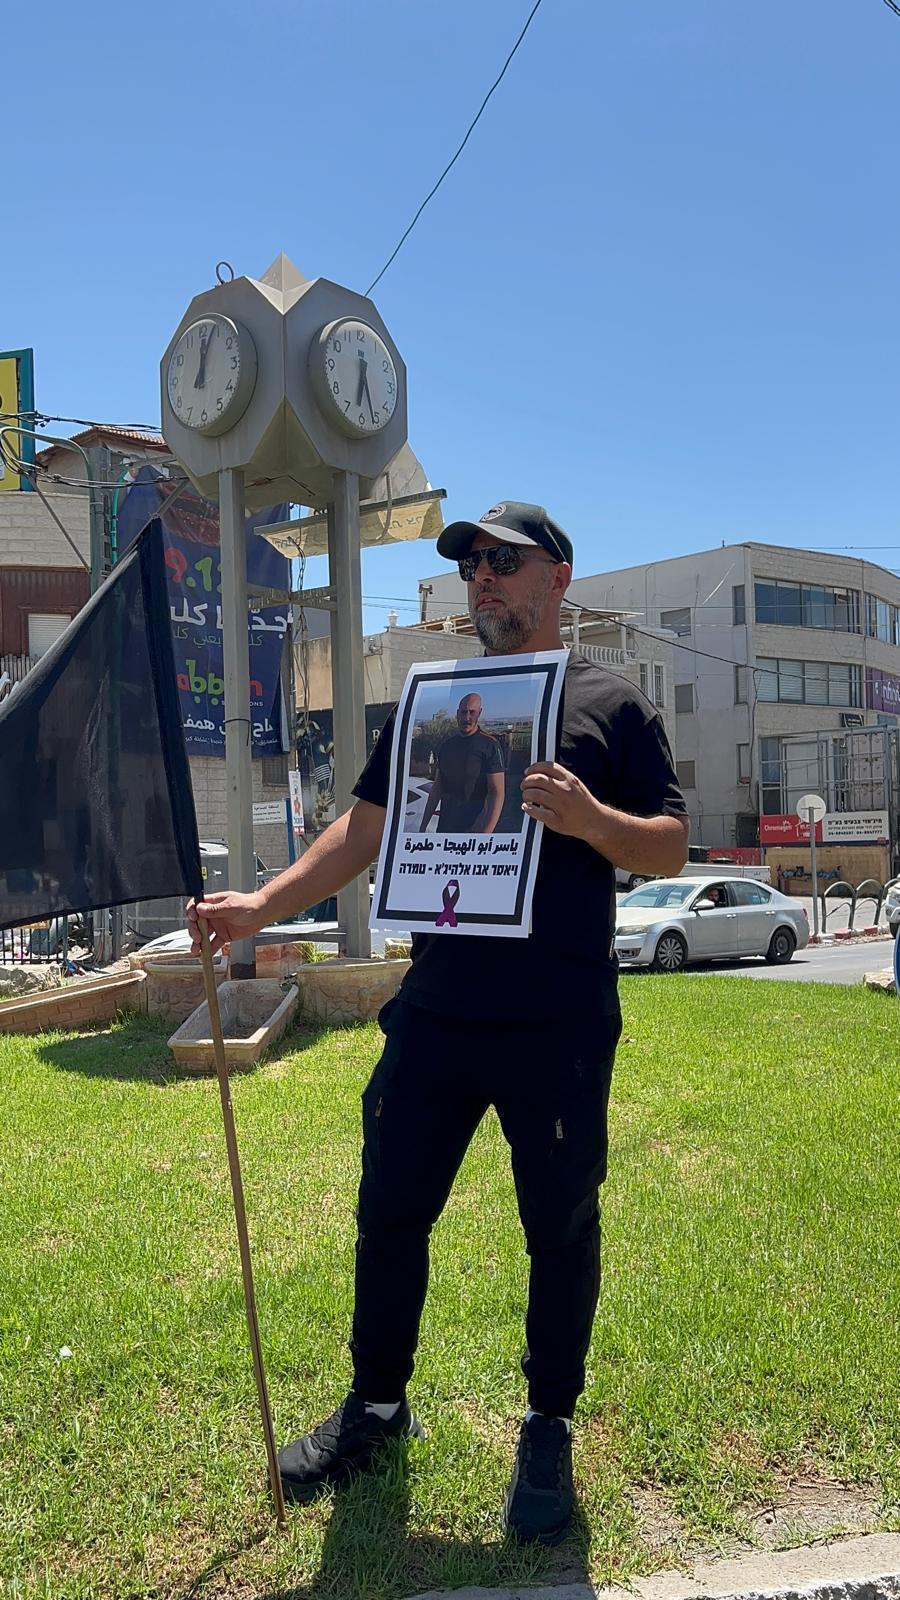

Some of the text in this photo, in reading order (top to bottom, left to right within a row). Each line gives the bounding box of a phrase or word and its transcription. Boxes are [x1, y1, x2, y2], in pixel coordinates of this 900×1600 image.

[344, 330, 351, 343] 11
[356, 330, 366, 343] 12
[226, 337, 233, 350] 2
[333, 340, 342, 353] 10
[231, 356, 238, 370] 3
[327, 358, 336, 372] 9
[382, 361, 390, 373] 2
[225, 379, 234, 392] 4
[332, 382, 340, 394] 8
[386, 382, 393, 394] 3
[216, 397, 224, 411] 5
[344, 400, 351, 413] 7
[382, 401, 389, 412] 4
[187, 406, 193, 421] 7
[200, 409, 208, 422] 6
[358, 412, 366, 425] 6
[404, 838, 434, 853] طمرة
[443, 839, 476, 856] الهيجا
[478, 837, 494, 855] أبو
[492, 838, 519, 855] ياسر
[399, 863, 426, 875] טמרה
[434, 862, 471, 876] אלהיג'א
[472, 864, 489, 876] אבו
